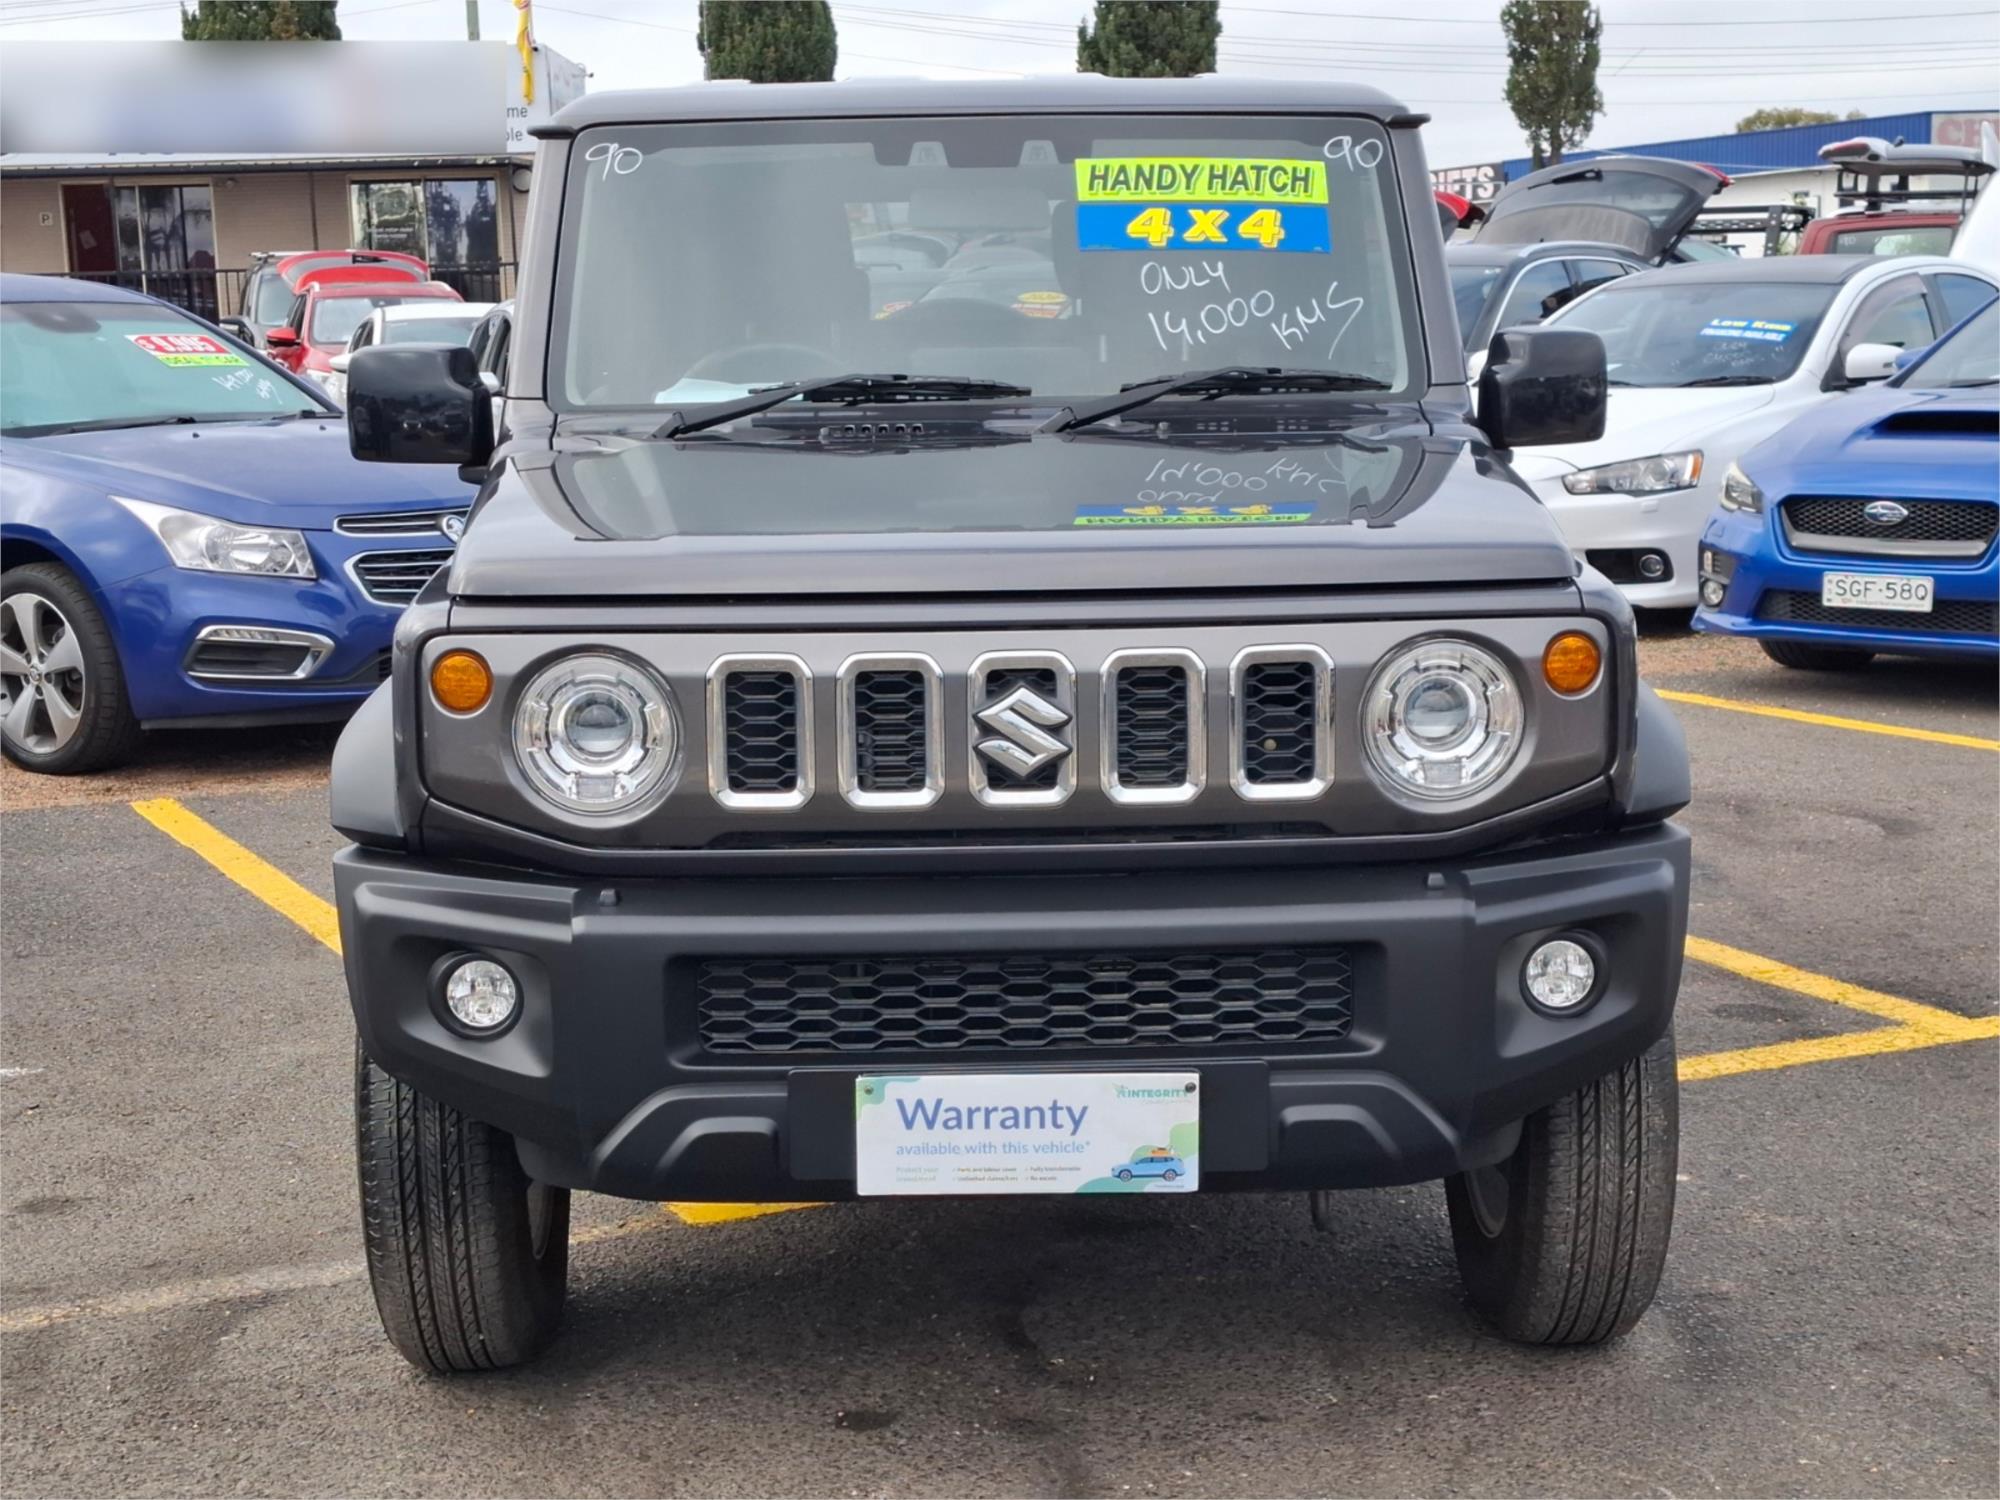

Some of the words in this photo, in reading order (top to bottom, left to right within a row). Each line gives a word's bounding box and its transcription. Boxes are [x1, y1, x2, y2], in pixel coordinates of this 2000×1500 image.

[584, 142, 643, 182] 90
[1323, 135, 1384, 172] 90
[1087, 163, 1203, 195] HANDY
[1206, 164, 1313, 197] HATCH
[1141, 261, 1231, 294] ONLY
[1271, 281, 1364, 360] KMS
[896, 1098, 1089, 1136] Warranty
[896, 1141, 961, 1156] available
[964, 1141, 998, 1155] with
[1002, 1140, 1030, 1154] this
